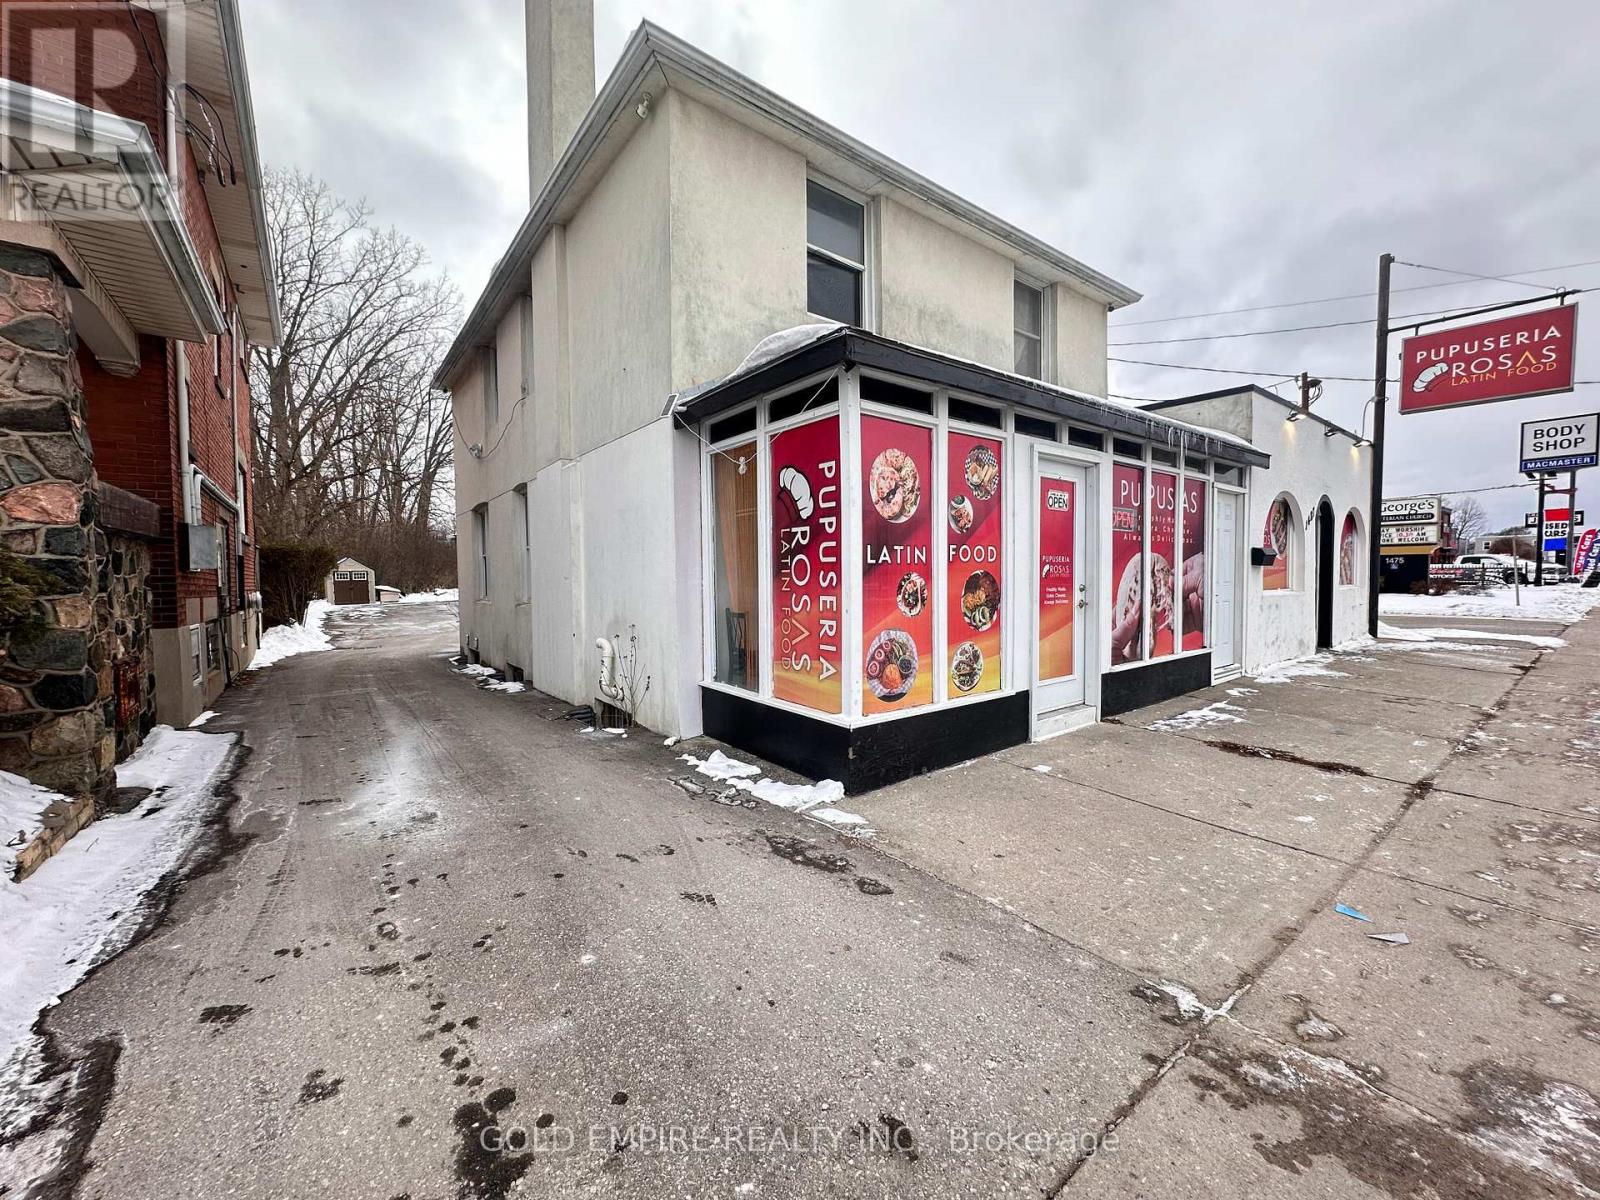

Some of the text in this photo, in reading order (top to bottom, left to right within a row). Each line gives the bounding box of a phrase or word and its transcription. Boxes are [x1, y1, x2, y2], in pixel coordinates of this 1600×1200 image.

[1416, 325, 1561, 363] PUPUSERIA
[1451, 362, 1557, 386] LATIN FOOD
[1533, 423, 1586, 440] BODY
[1532, 437, 1586, 452] SHOP
[1526, 457, 1591, 468] MACMASTER
[1047, 495, 1068, 509] OPEN
[866, 544, 997, 564] LATIN FOOD
[818, 460, 839, 680] PUPUSERIA
[780, 528, 791, 670] LATIN FOOD
